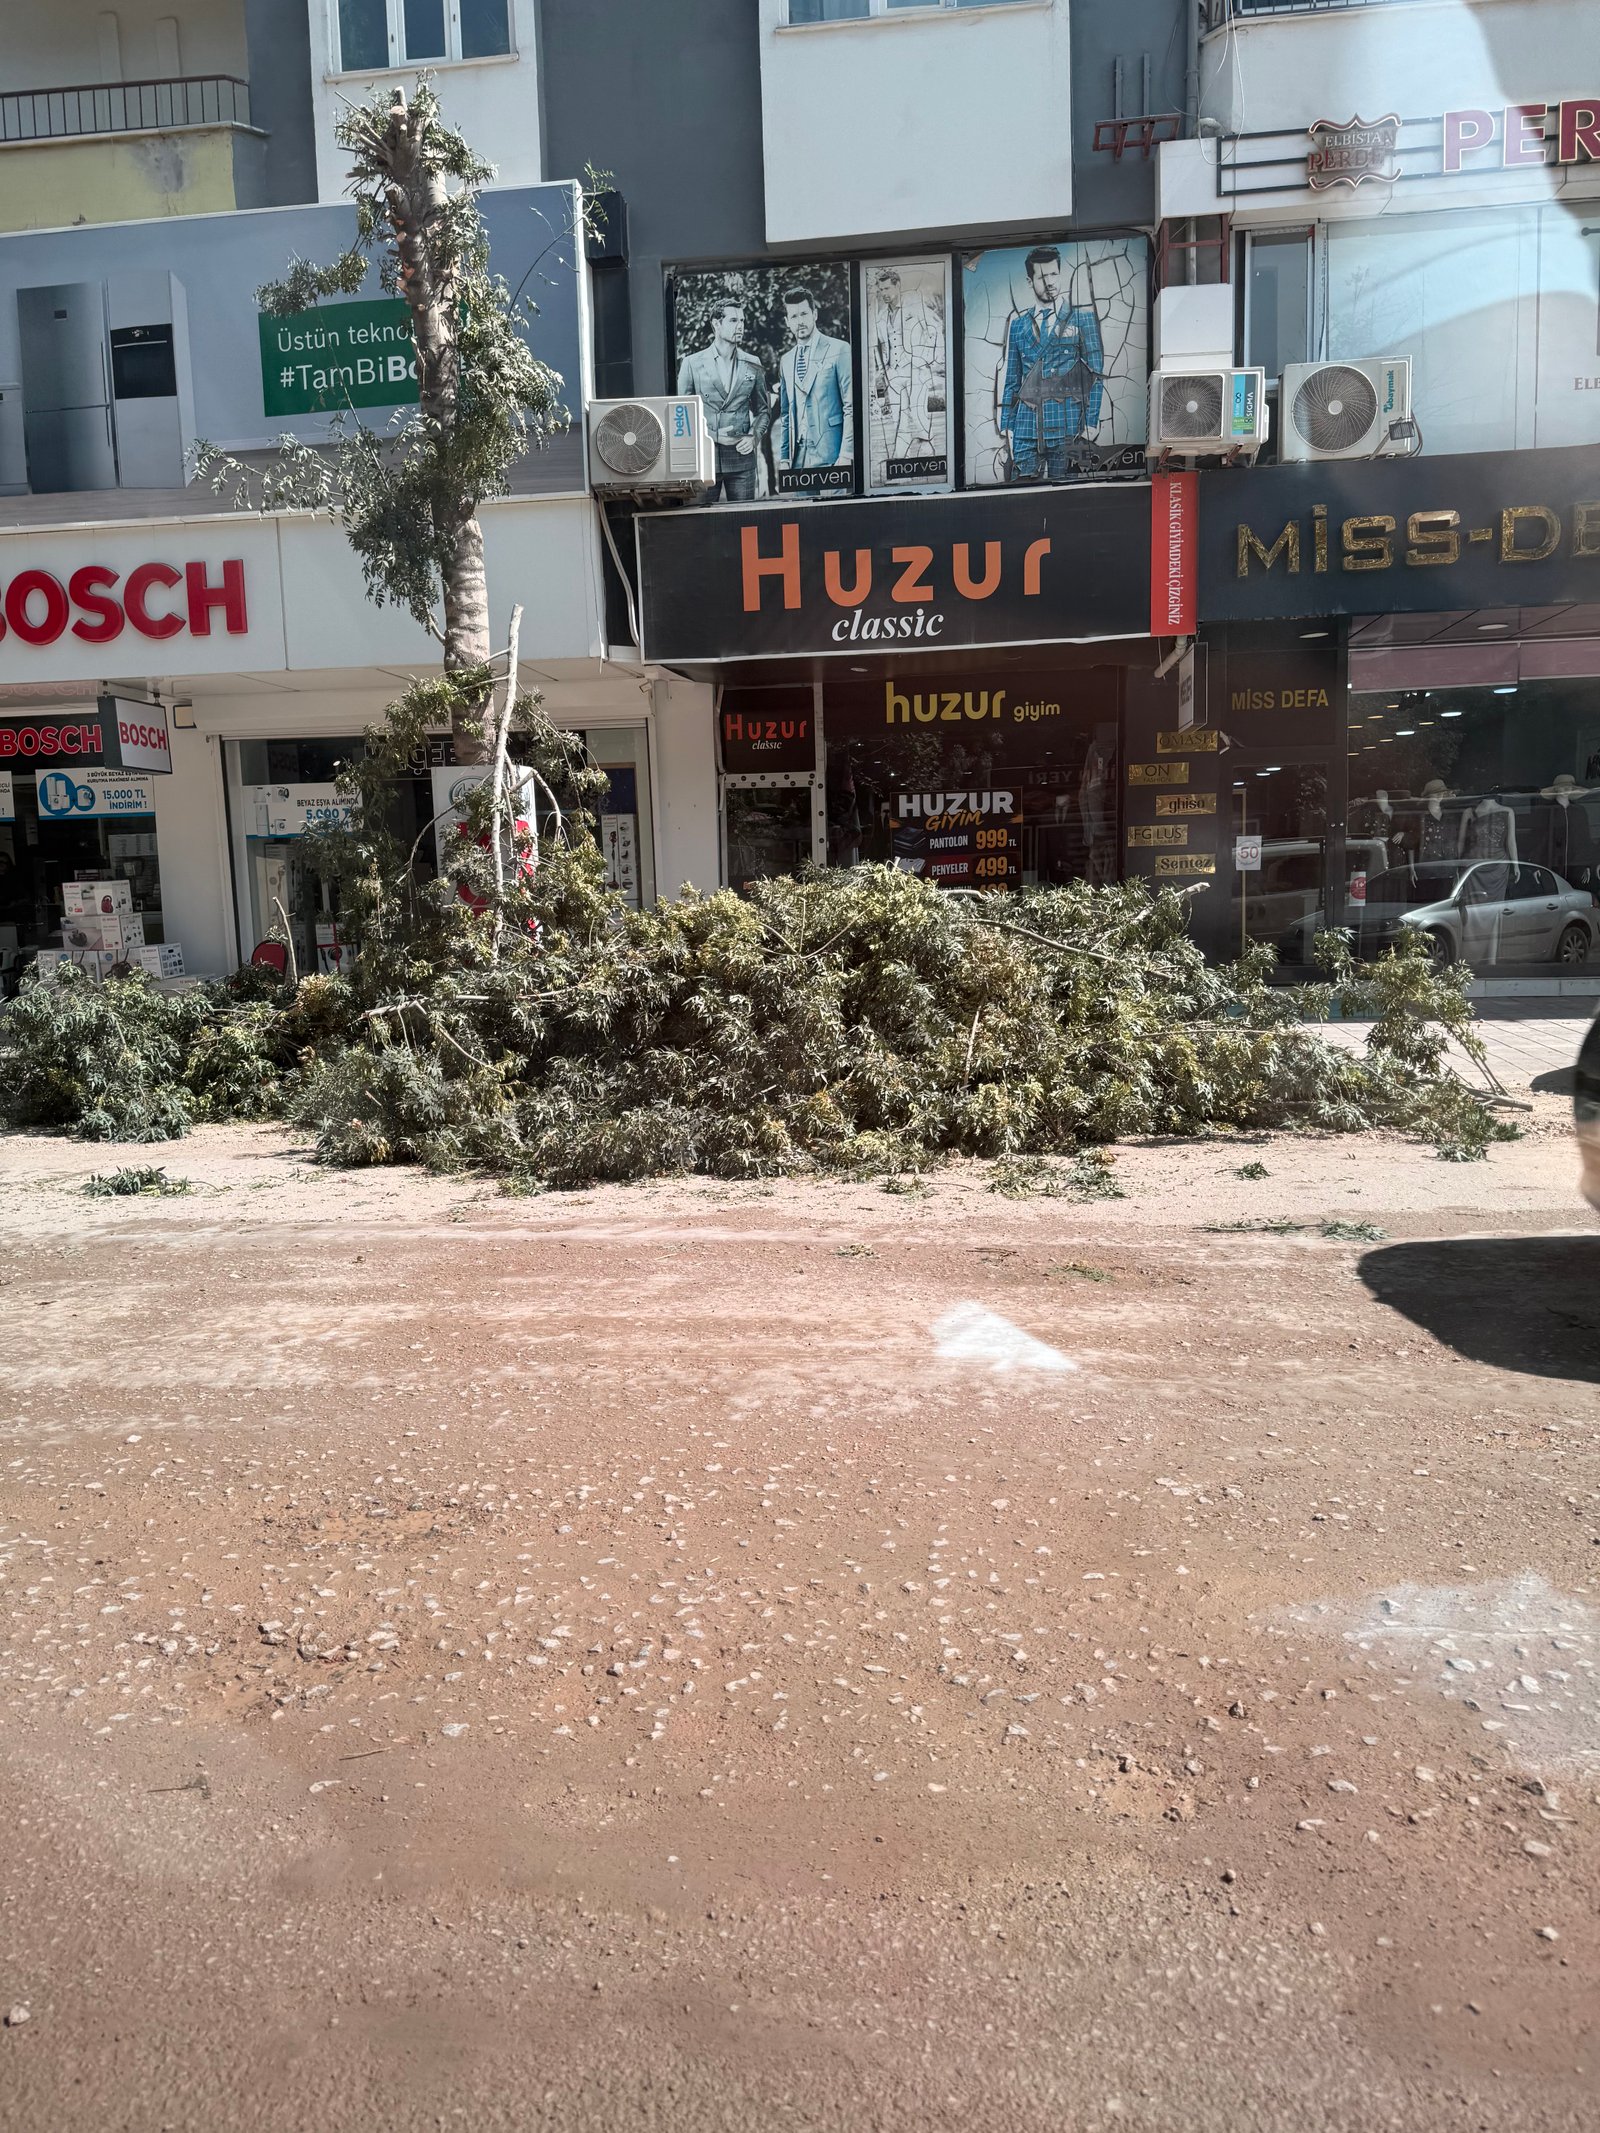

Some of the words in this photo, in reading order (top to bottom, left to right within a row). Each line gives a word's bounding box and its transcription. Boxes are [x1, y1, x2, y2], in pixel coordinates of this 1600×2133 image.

[277, 327, 340, 353] Üstün
[674, 405, 684, 437] beko
[781, 467, 852, 488] morven
[888, 456, 948, 476] morven
[1169, 482, 1184, 519] KLASİK
[1168, 521, 1184, 578] GİYİMDEKİ
[741, 524, 1051, 612] Huzur
[0, 558, 249, 646] OSCH
[1165, 579, 1184, 625] ÇİZGİNİZ
[831, 608, 944, 643] classic
[885, 681, 1006, 724] huzur
[1013, 699, 1061, 723] giyim
[1231, 688, 1275, 711] MİSS
[1280, 687, 1328, 709] DEFA
[119, 721, 168, 751] BOSCH
[725, 713, 808, 741] Huzur
[0, 724, 103, 757] BOSCH
[751, 739, 783, 750] classic
[1144, 765, 1170, 777] ON
[102, 789, 133, 801] 15.000
[135, 788, 147, 799] TL
[109, 799, 143, 811] İNDİRİM
[296, 799, 316, 807] BEYAZ
[316, 798, 331, 807] EŞYA
[898, 790, 1014, 818] HUZUR
[925, 808, 984, 832] GİYİM
[929, 834, 969, 850] PANTOLON
[975, 828, 1008, 850] 999
[931, 862, 969, 877] PENYELER
[975, 856, 1008, 878] 499
[1160, 857, 1212, 871] Sentez
